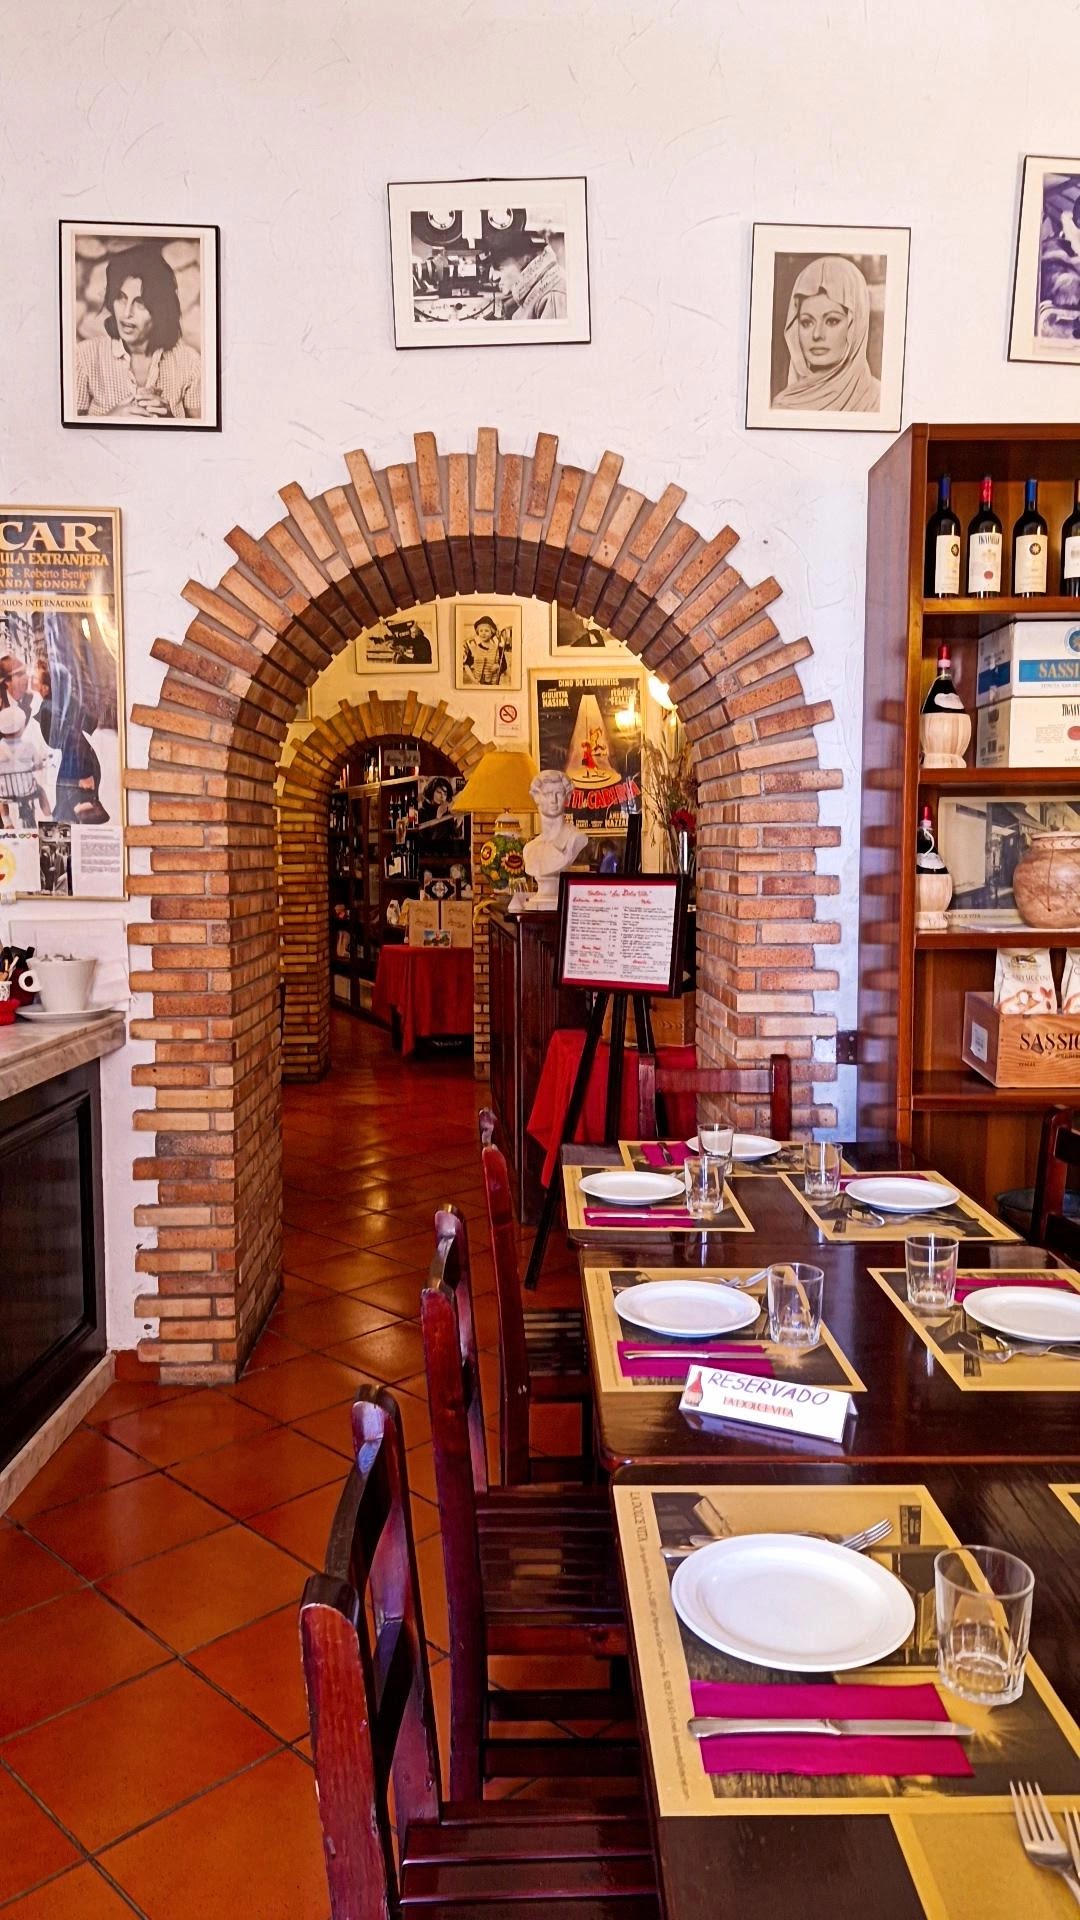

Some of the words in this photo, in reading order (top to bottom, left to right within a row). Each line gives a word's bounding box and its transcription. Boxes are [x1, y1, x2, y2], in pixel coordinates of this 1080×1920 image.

[29, 553, 109, 567] EXTRANJERA
[23, 567, 59, 579] Roberto
[35, 580, 86, 590] SONORA
[708, 1372, 830, 1405] RESERVADO
